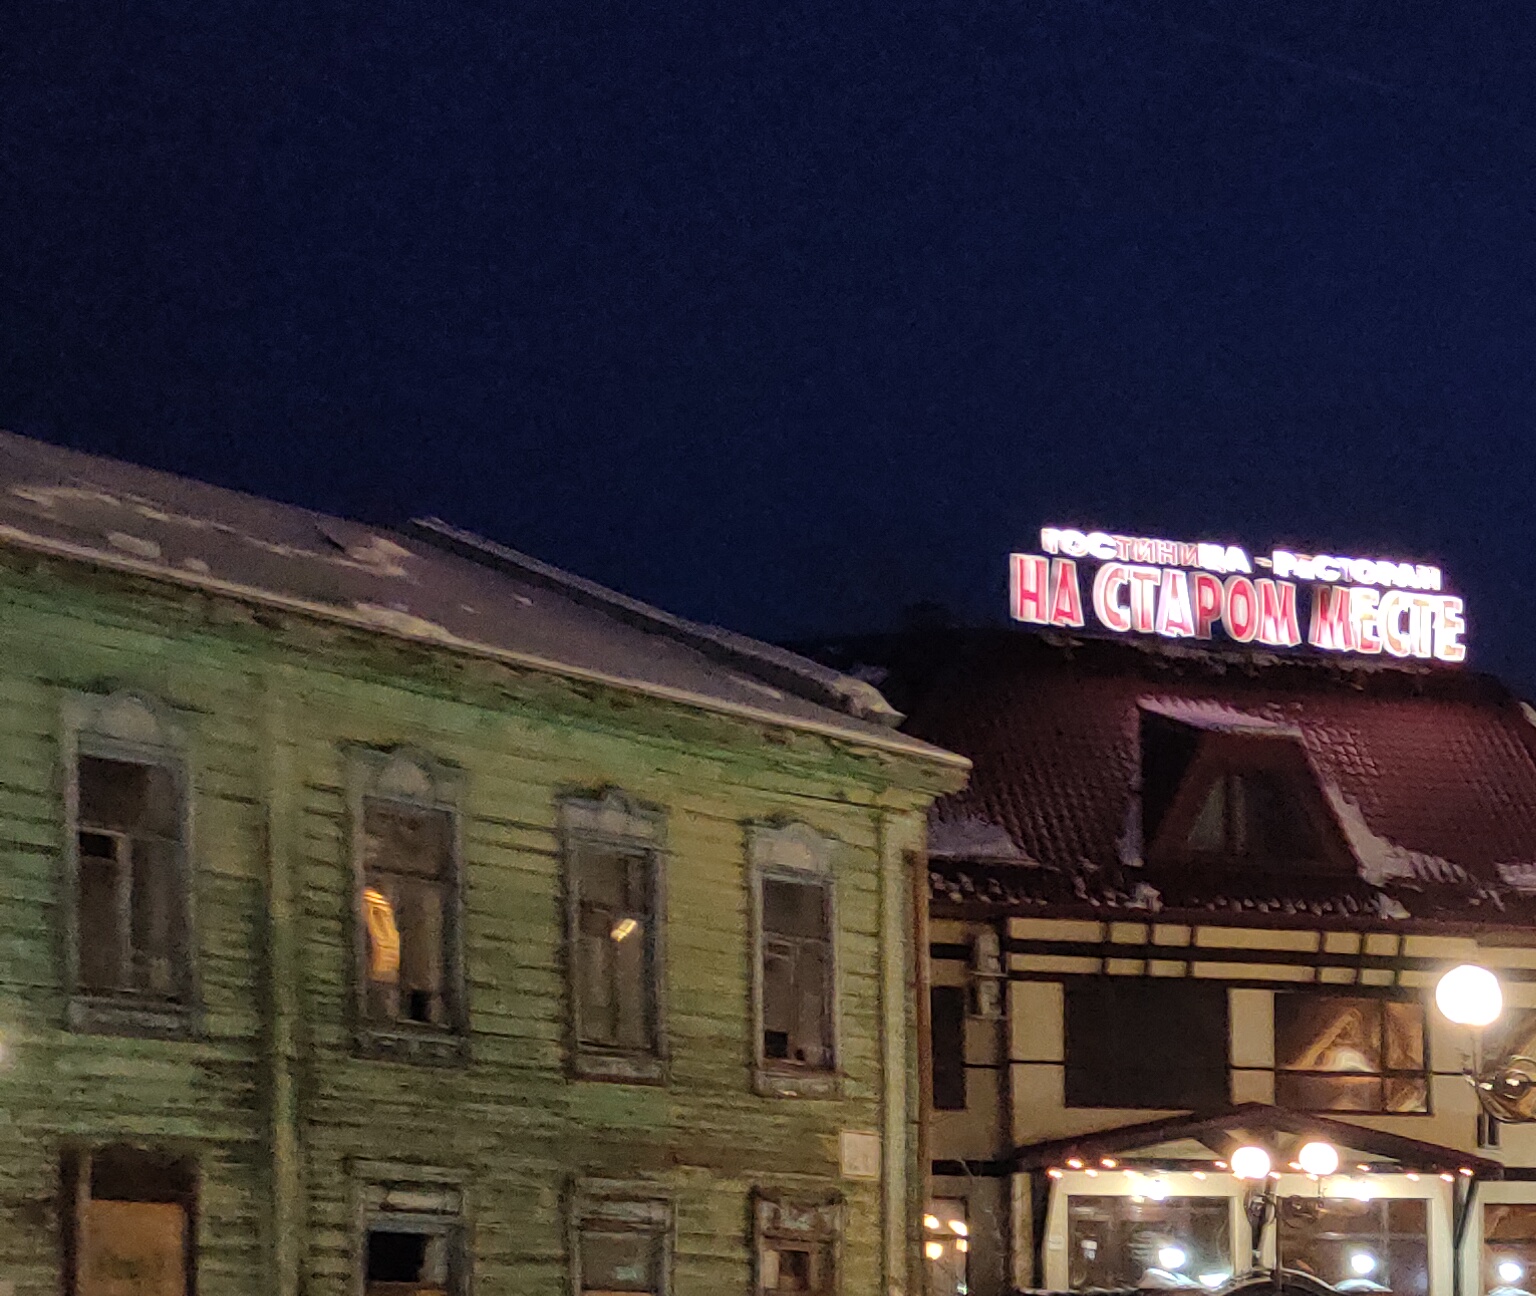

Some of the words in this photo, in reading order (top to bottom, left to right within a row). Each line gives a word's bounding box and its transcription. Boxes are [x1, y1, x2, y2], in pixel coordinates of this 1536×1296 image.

[1009, 552, 1084, 627] НА
[1092, 561, 1301, 646] СТАРОМ
[1308, 583, 1467, 662] МЕСТЕ
